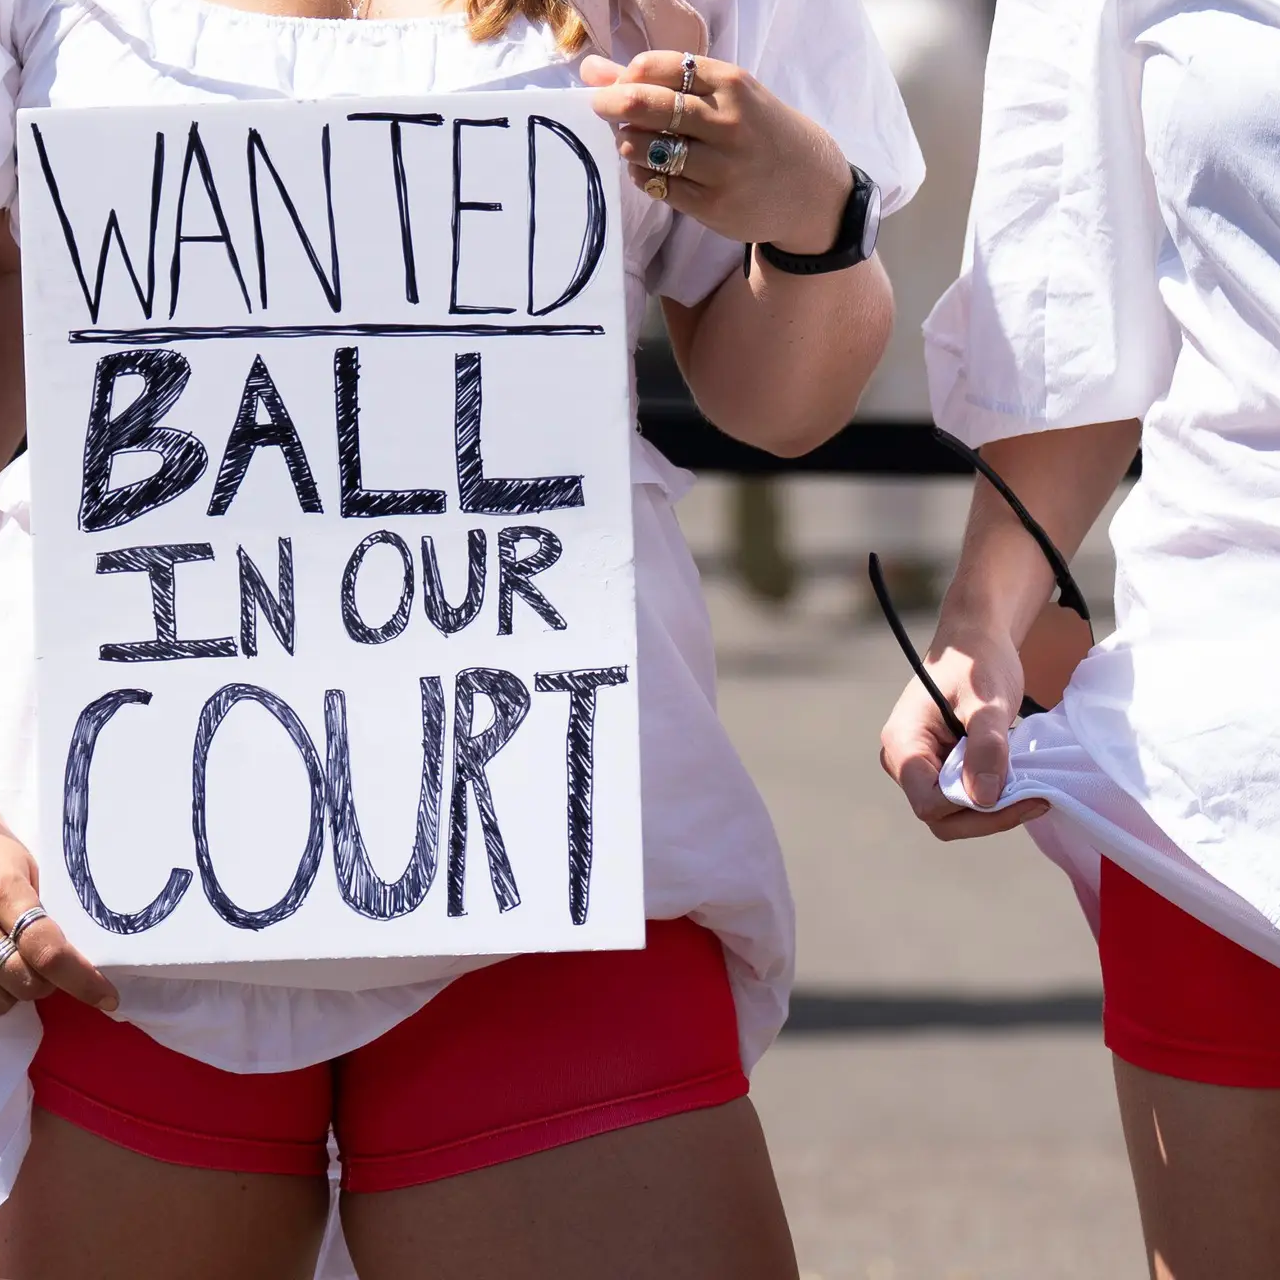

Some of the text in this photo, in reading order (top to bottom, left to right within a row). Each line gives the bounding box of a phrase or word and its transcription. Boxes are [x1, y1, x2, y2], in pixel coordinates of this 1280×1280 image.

[30, 112, 607, 321] WANTED
[77, 346, 586, 533] BALL
[95, 525, 568, 660] IN OUR
[62, 664, 630, 935] COURT
